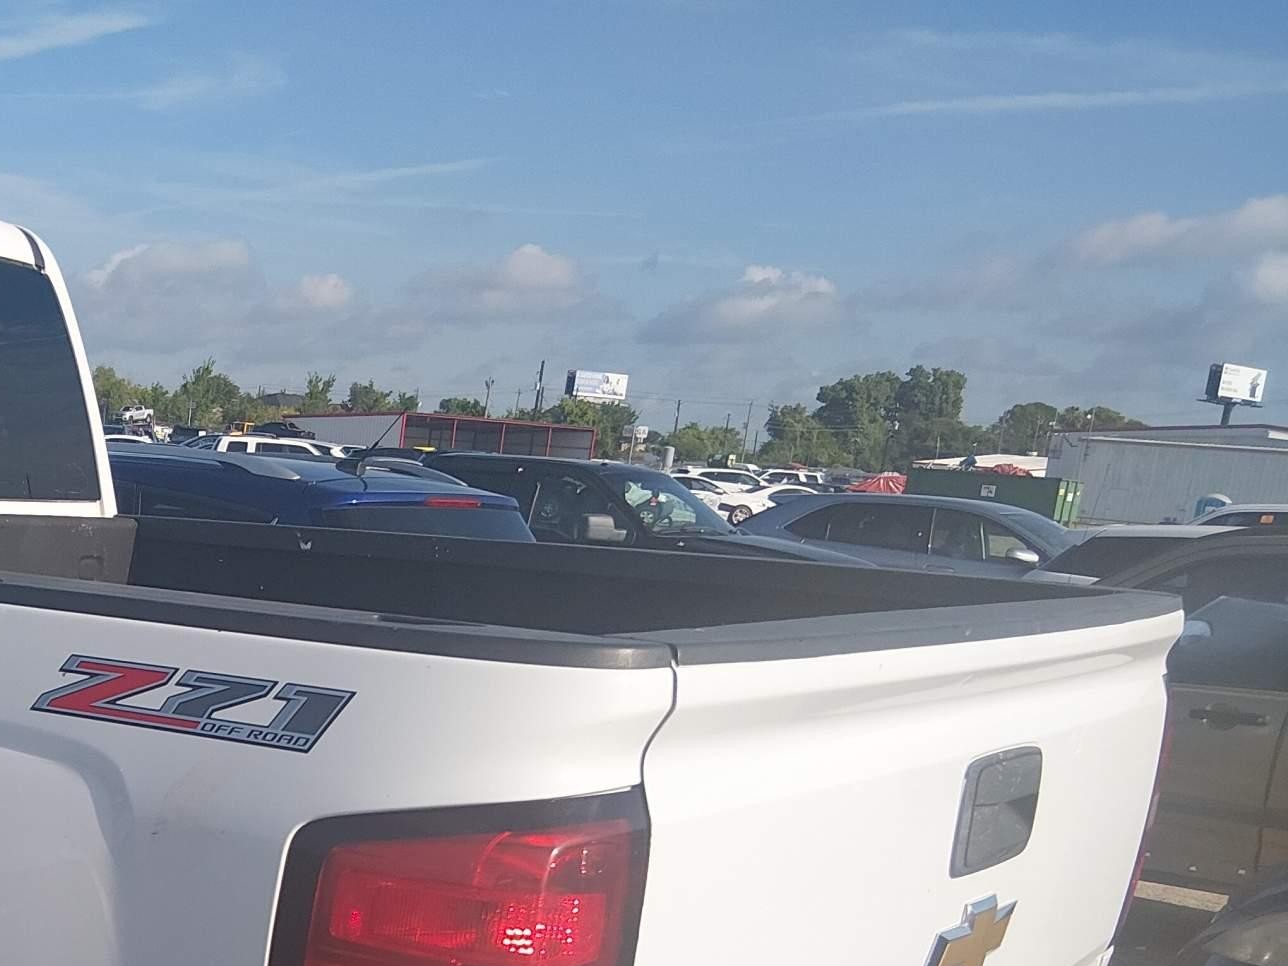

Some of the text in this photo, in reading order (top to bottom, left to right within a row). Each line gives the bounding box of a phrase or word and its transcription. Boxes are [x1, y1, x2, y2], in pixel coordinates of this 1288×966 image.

[30, 654, 358, 754] Z71
[200, 722, 311, 747] OFF ROAD
